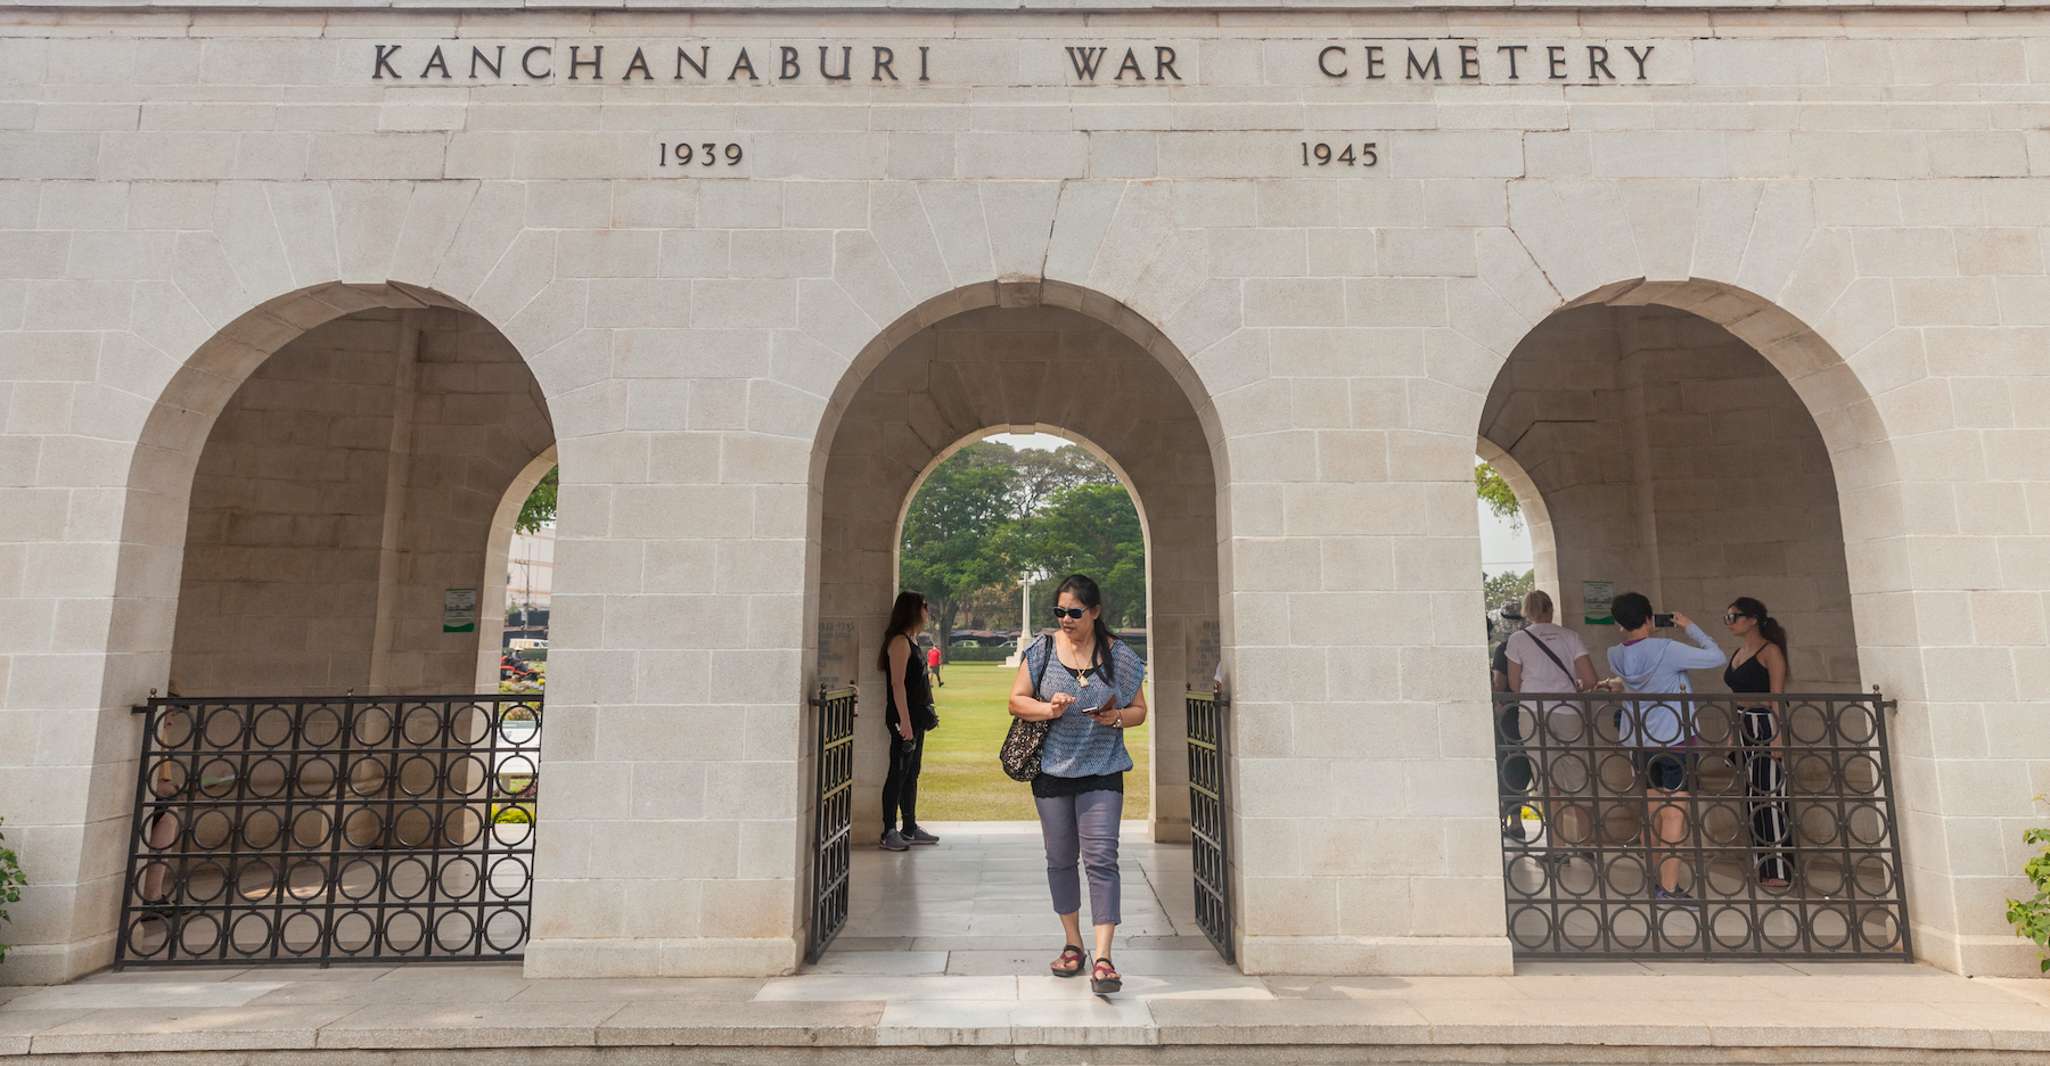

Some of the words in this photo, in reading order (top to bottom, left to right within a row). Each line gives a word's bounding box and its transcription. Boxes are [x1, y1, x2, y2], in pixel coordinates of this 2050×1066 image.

[372, 45, 930, 82] KANCHANABURI
[1065, 46, 1182, 81] WAR
[1318, 45, 1655, 81] CEMETERY
[659, 142, 743, 167] 1939
[1301, 142, 1378, 167] 1945
